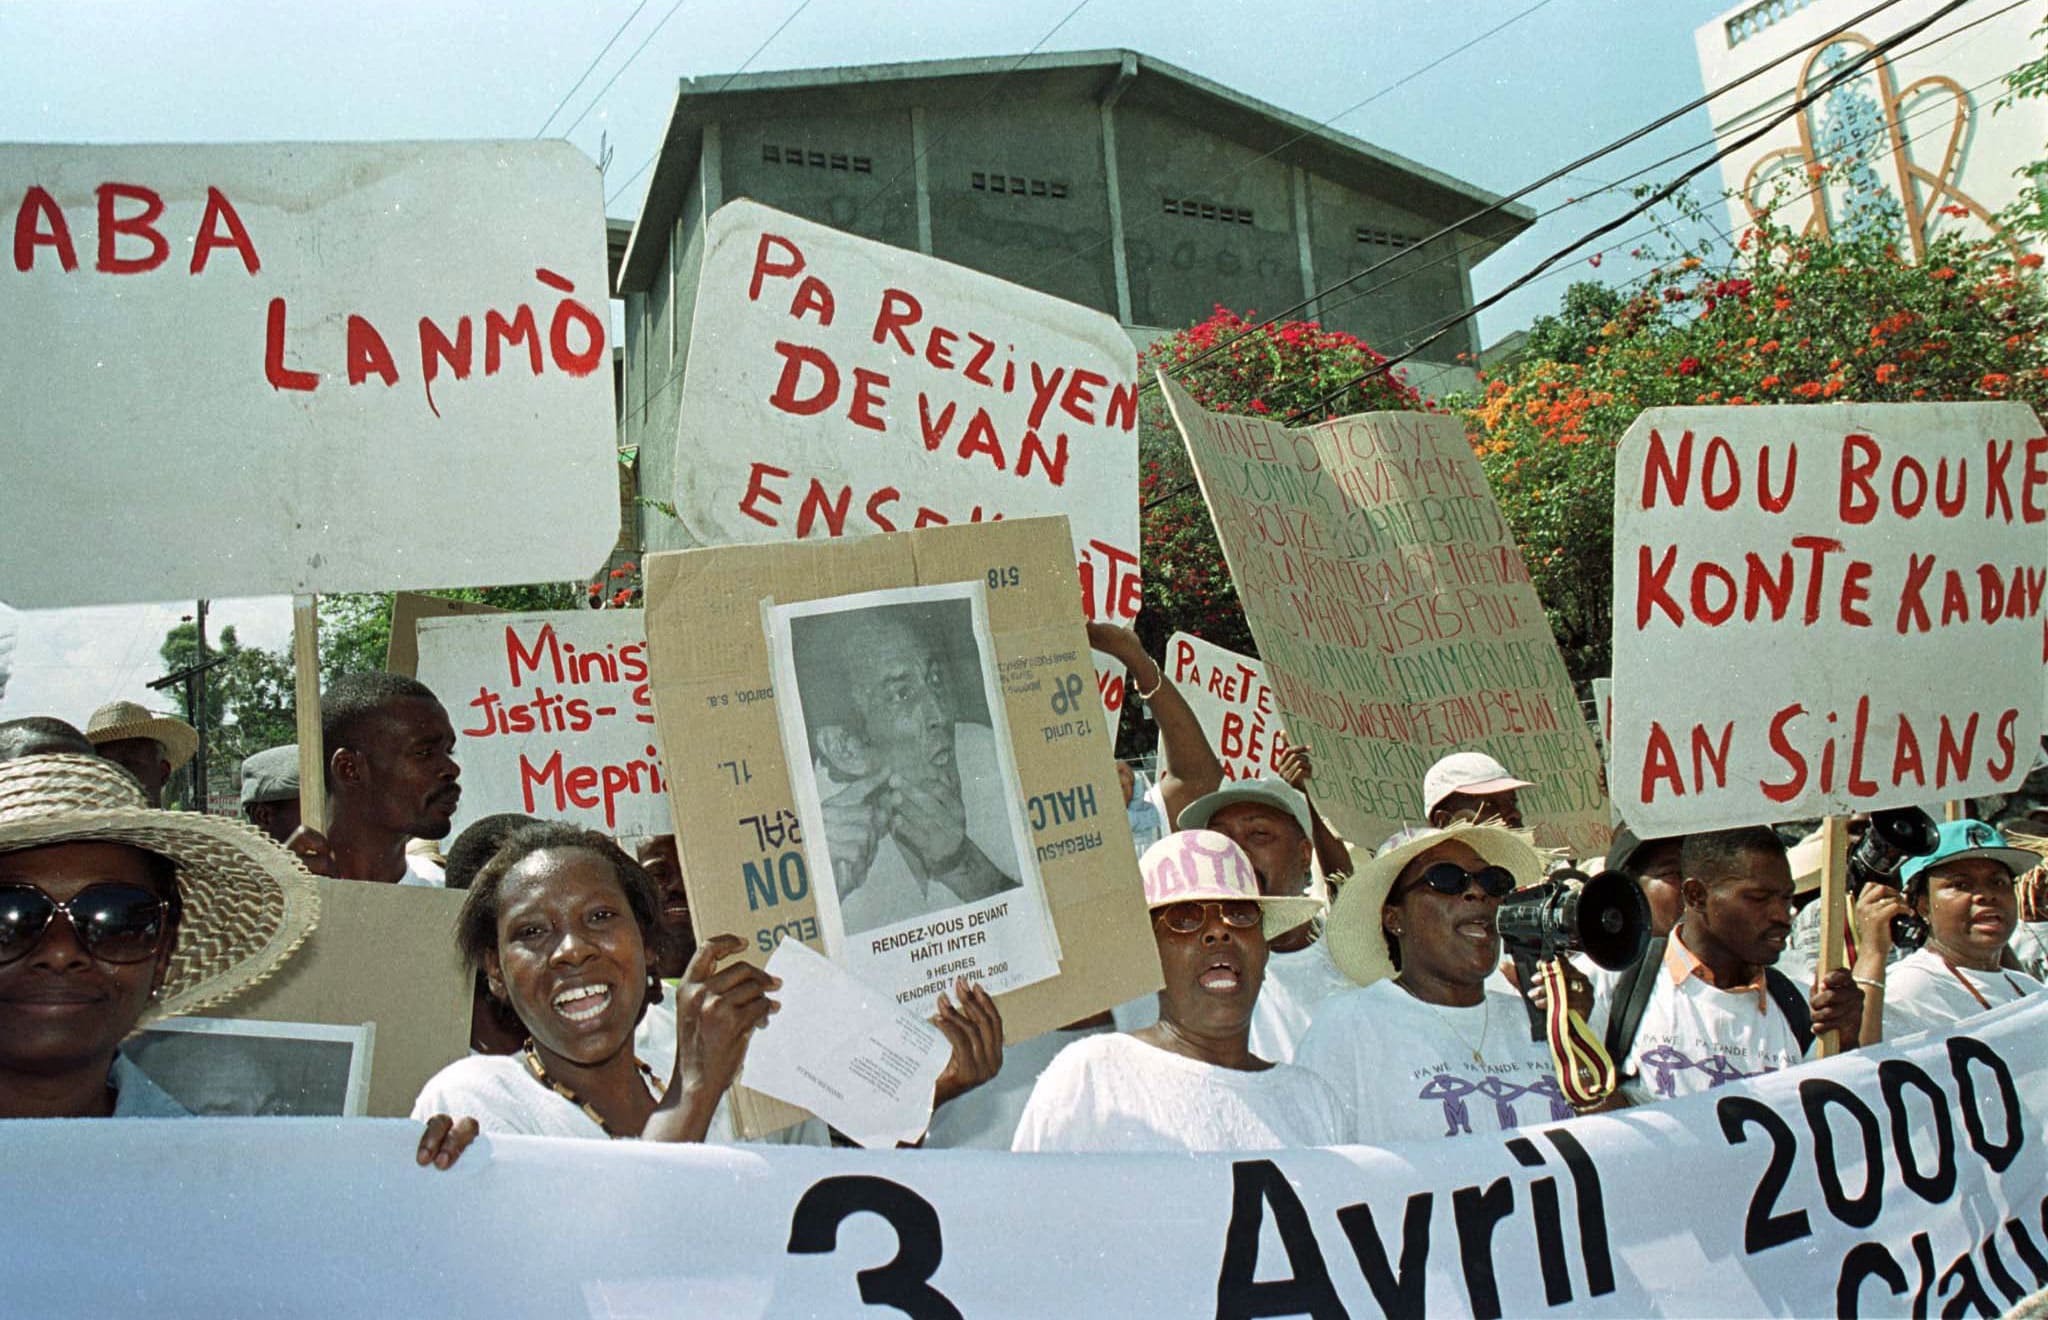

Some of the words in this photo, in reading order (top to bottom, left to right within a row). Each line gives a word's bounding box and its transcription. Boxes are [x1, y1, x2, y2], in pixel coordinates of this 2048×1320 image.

[13, 183, 260, 275] ABA
[749, 233, 836, 327] PA
[265, 268, 606, 393] LANMÒ
[1641, 428, 1797, 514] NOU
[1839, 434, 2048, 525] BOUKE
[1636, 535, 1846, 631] KONTE
[1896, 552, 2047, 634] KADAV
[505, 623, 648, 688] Minis
[1175, 640, 1201, 687] PA
[1208, 663, 1273, 716] RETE
[1074, 719, 1093, 739] 12
[1640, 718, 1735, 804] AN
[519, 750, 669, 829] Mepri
[742, 851, 810, 912] ON
[871, 920, 965, 955] RENDEZ-VOUS
[967, 903, 1010, 928] DEVANT
[934, 957, 977, 977] HEURES
[947, 931, 987, 954] INTER
[896, 980, 948, 1005] VENDREDI
[1481, 1062, 1521, 1075] TANDE
[788, 1174, 966, 1320] 3
[1216, 1128, 1616, 1320] Avril
[1716, 1035, 2025, 1256] 2000
[1836, 1195, 2048, 1320] Clau
